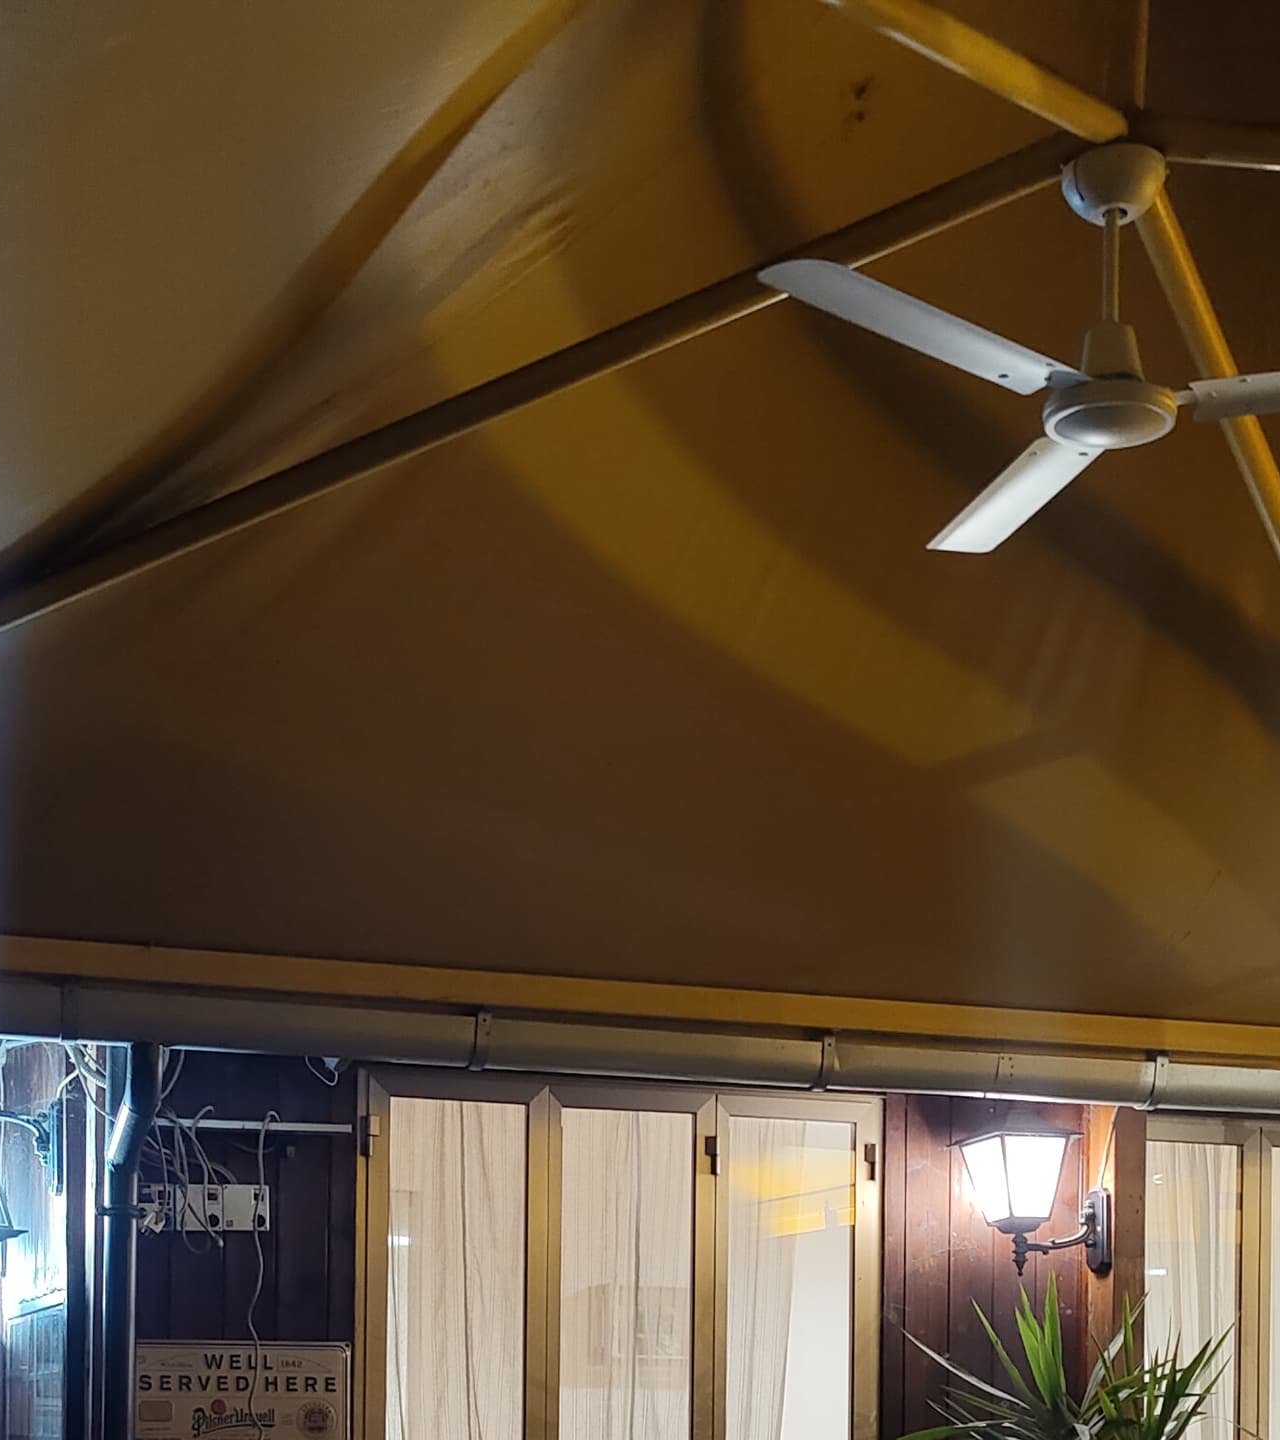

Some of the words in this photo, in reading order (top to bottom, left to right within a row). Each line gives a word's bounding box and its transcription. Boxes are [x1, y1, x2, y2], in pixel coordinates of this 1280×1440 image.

[204, 1354, 273, 1370] WELL
[138, 1375, 251, 1391] SERVED
[265, 1376, 337, 1392] HERE
[234, 1408, 275, 1426] Uruell
